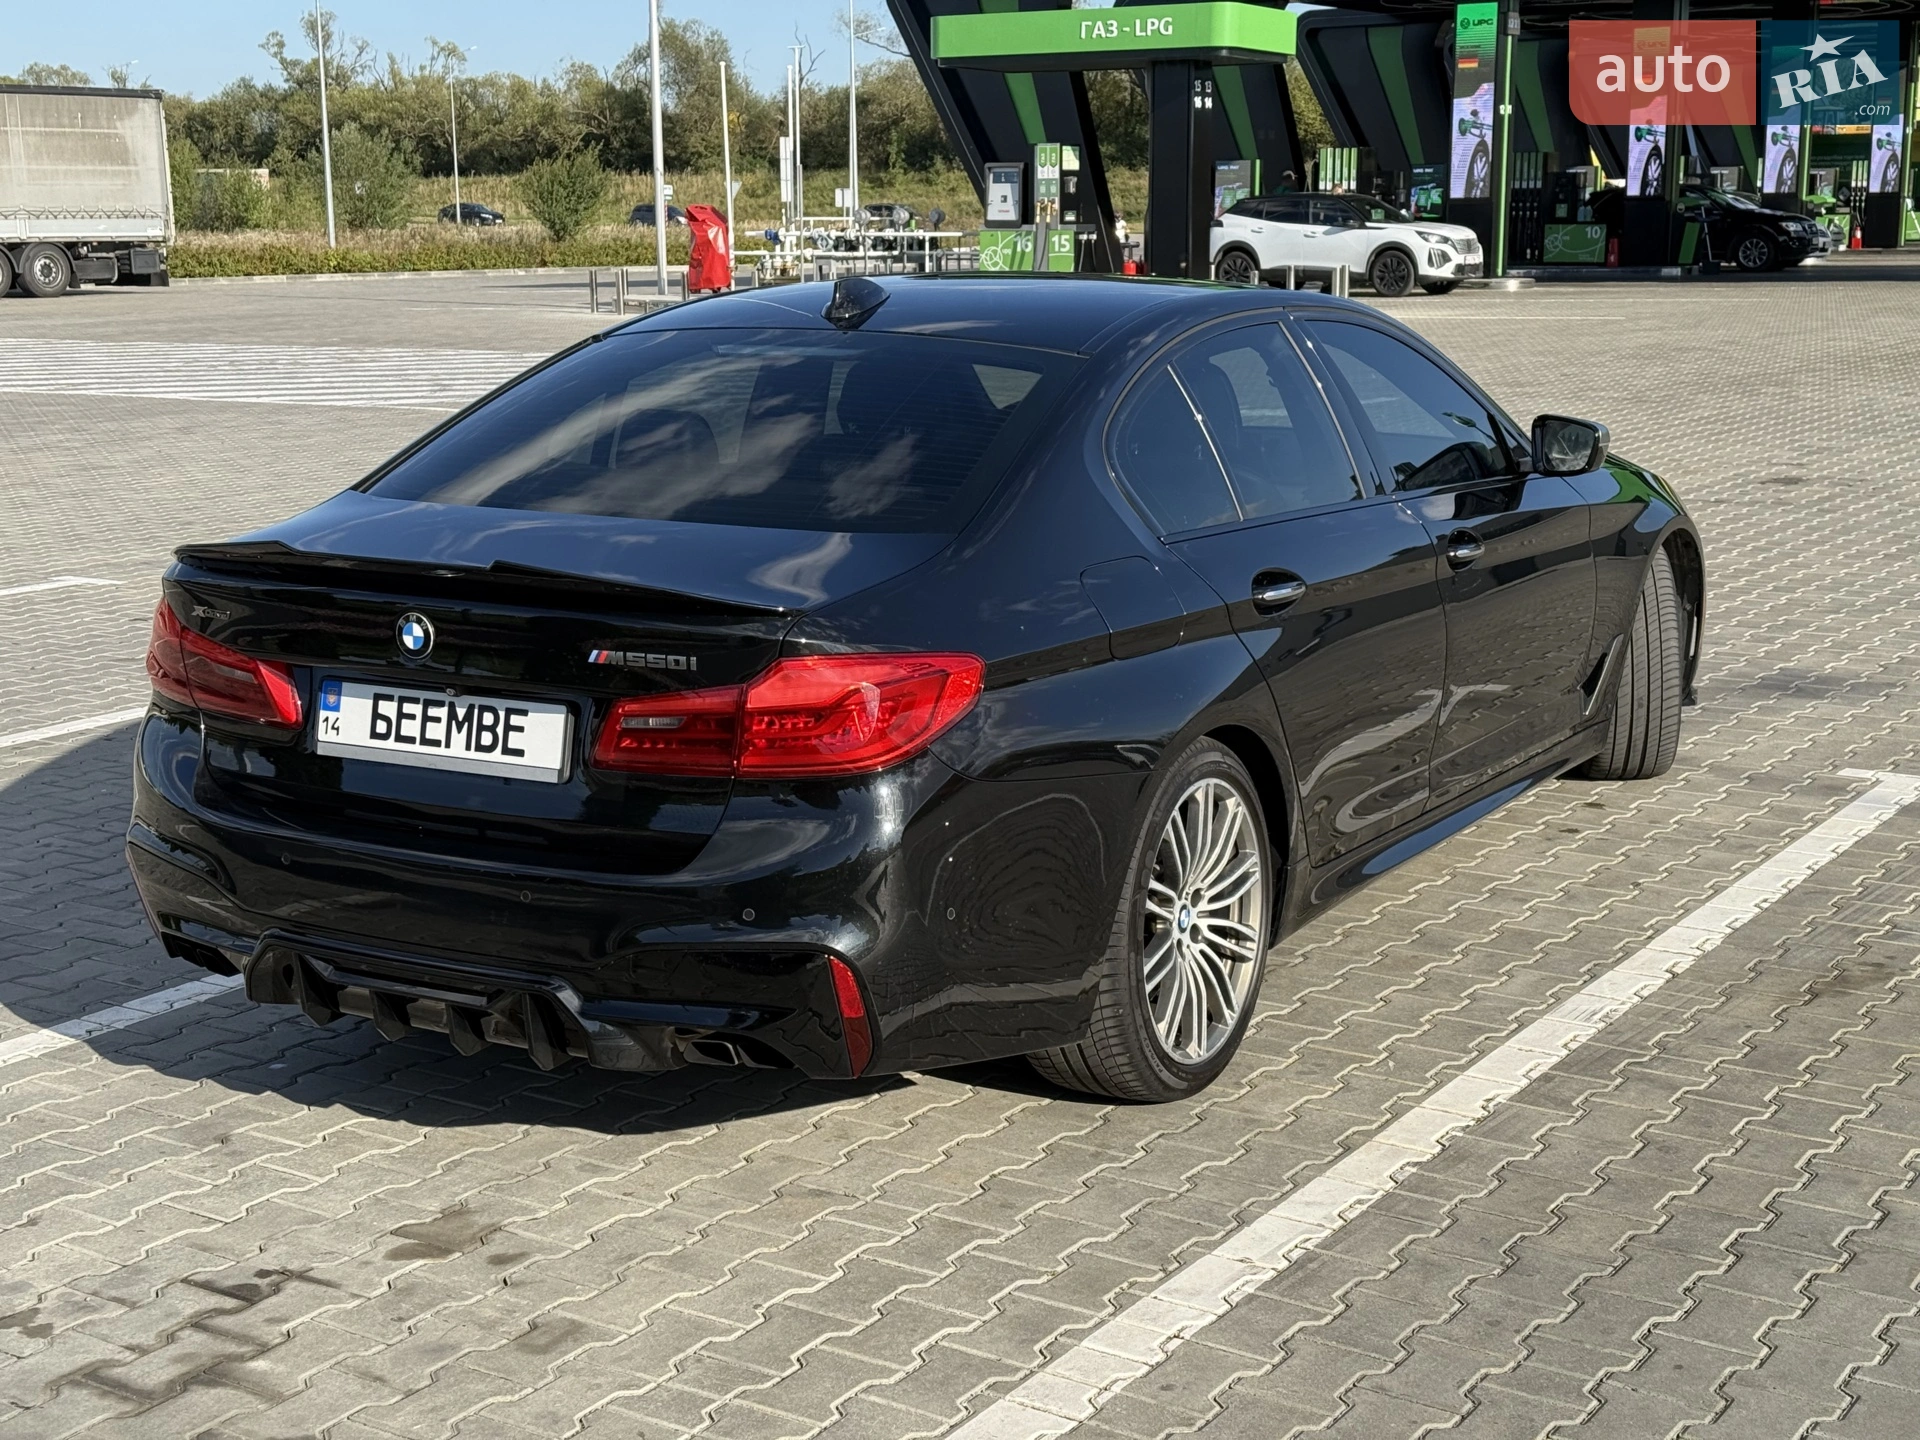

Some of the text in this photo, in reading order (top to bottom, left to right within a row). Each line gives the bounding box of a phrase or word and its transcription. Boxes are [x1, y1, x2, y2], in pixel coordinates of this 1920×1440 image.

[1080, 20, 1118, 39] ГАЗ
[1134, 17, 1173, 37] LPG
[1472, 18, 1494, 26] UPG
[1585, 226, 1601, 239] 10
[1014, 234, 1071, 253] 16 15
[603, 650, 697, 671] M550i
[322, 715, 341, 737] 14
[369, 692, 530, 758] БЕЕМВЕ
